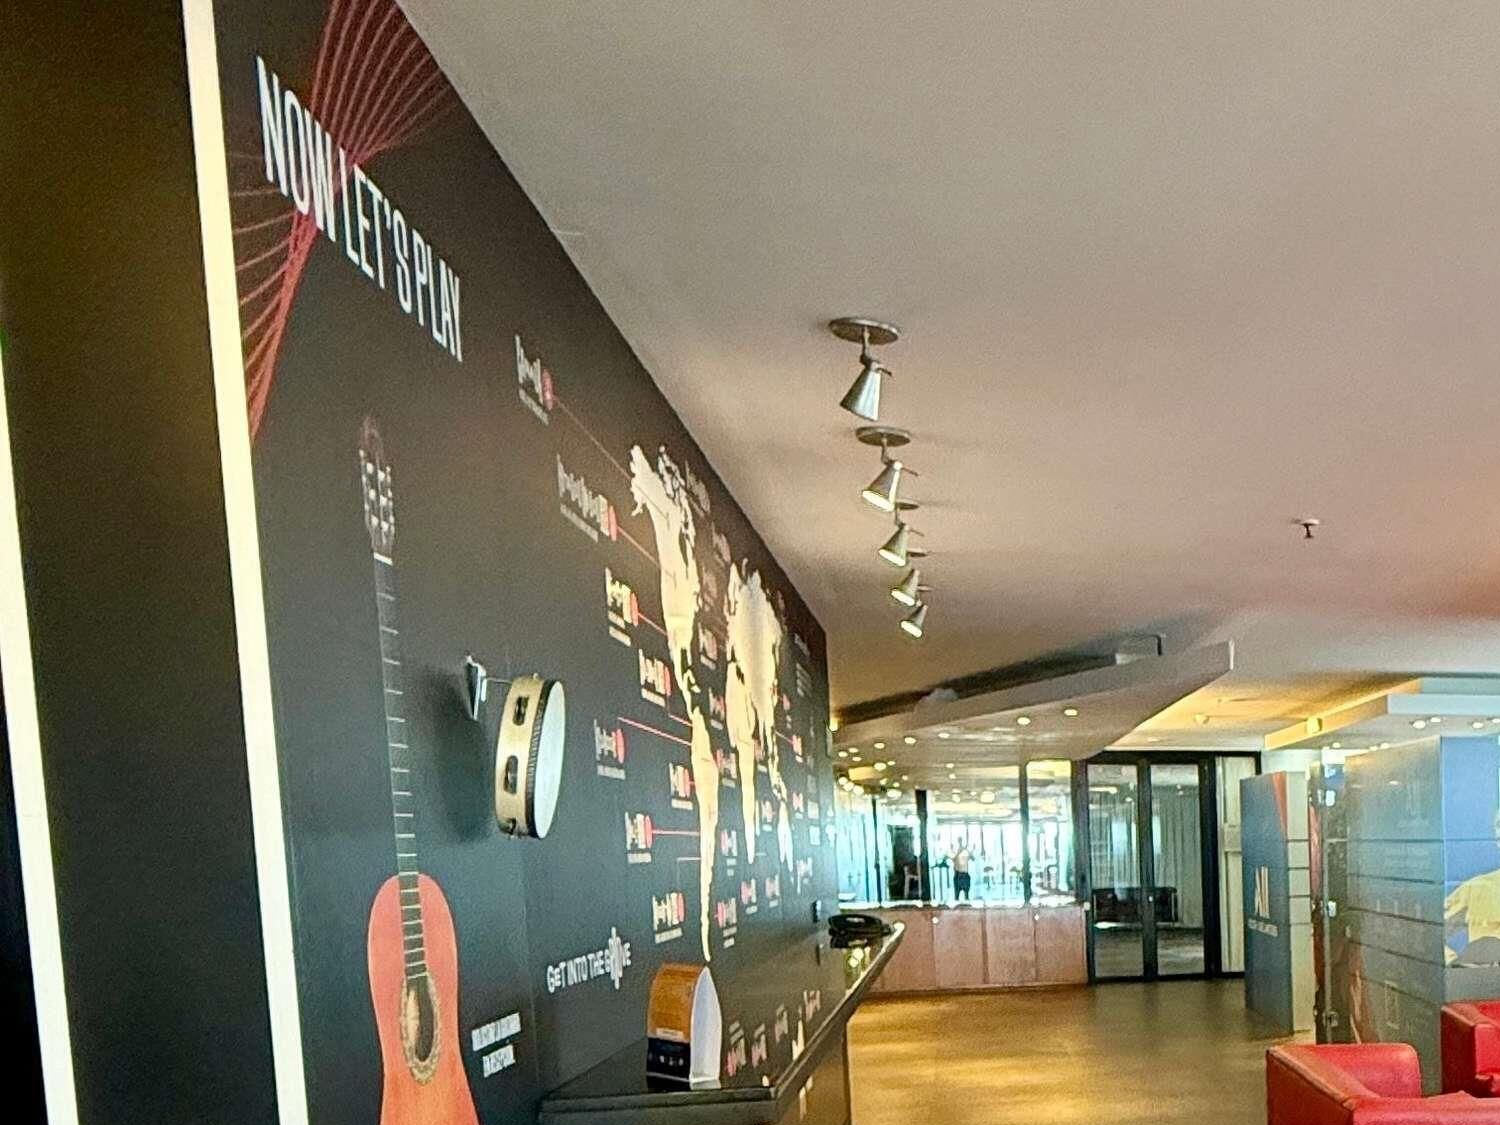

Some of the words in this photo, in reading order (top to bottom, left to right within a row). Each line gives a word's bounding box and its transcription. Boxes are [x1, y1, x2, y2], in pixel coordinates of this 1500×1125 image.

[256, 55, 336, 242] NOW
[339, 147, 413, 314] LET'S
[412, 228, 463, 362] PLAY
